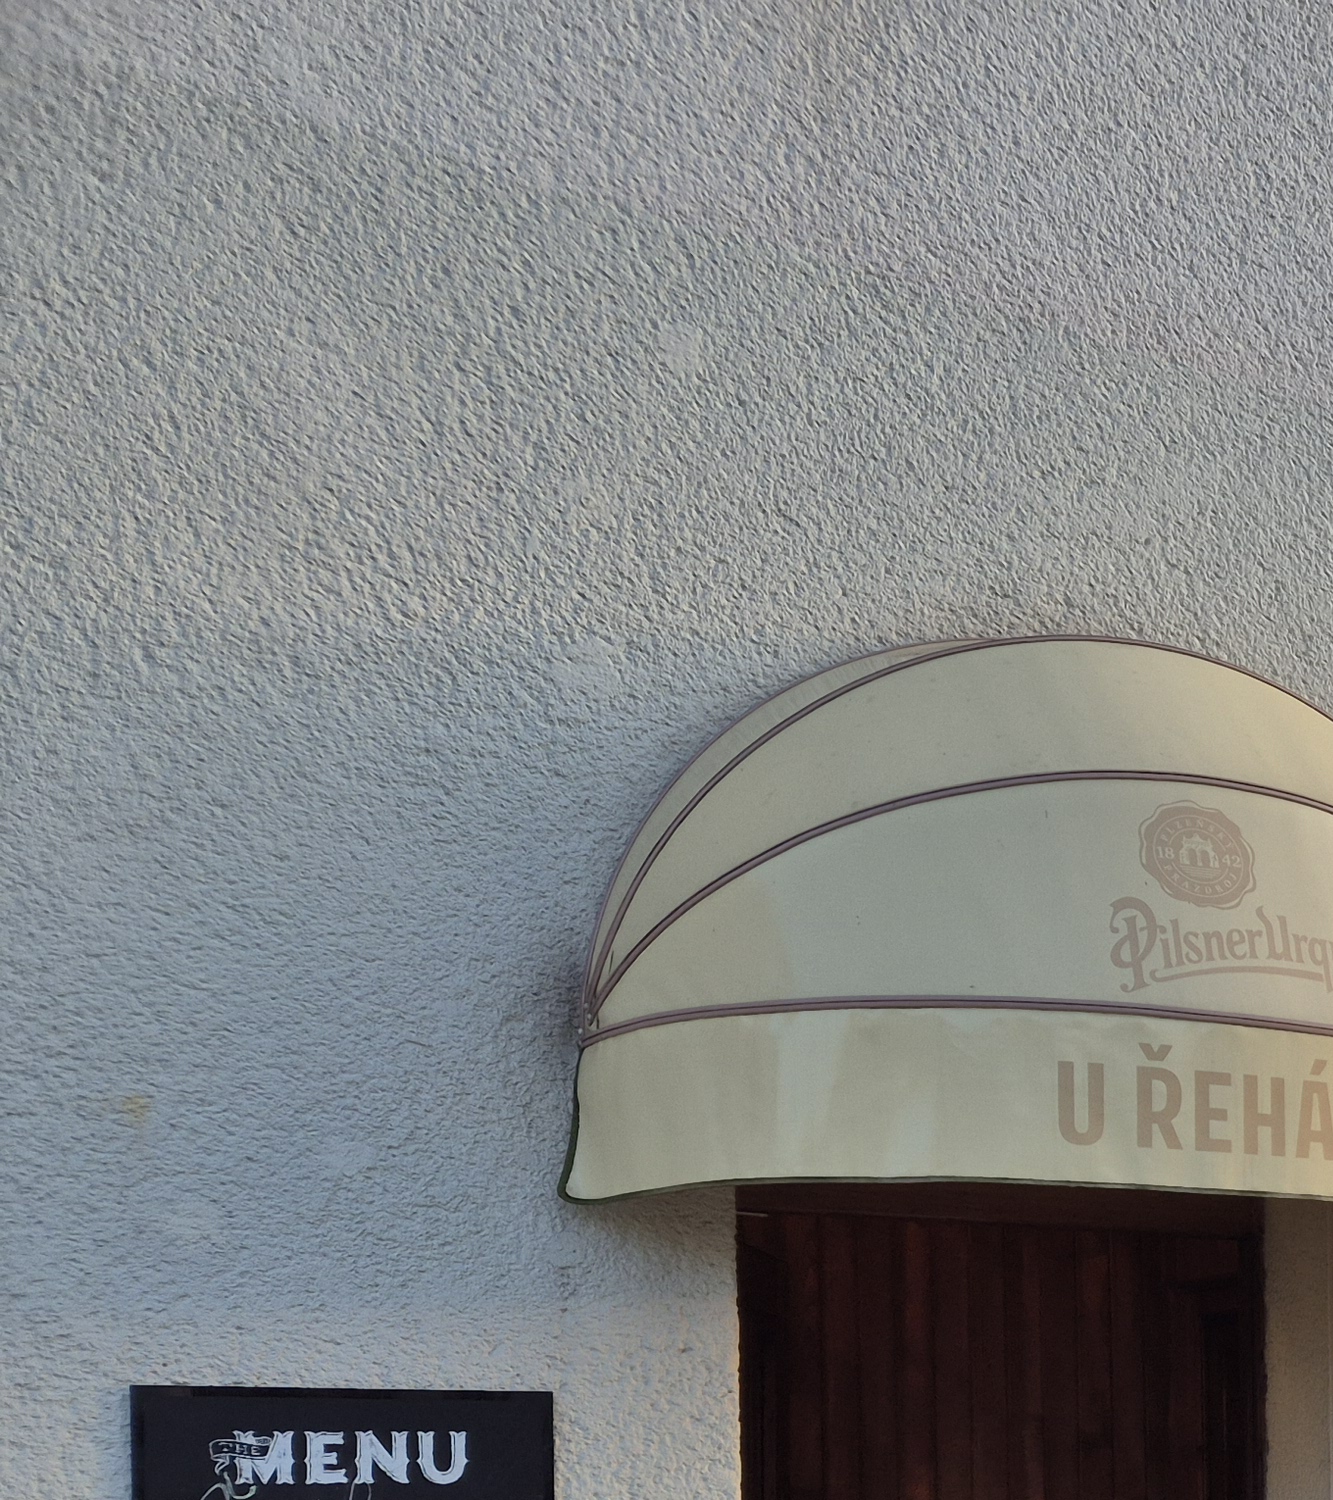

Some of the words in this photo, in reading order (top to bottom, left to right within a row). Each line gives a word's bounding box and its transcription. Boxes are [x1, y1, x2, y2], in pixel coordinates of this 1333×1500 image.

[1156, 846, 1175, 860] 18
[1221, 854, 1242, 868] 42
[1109, 896, 1263, 993] Pilsner
[1056, 1060, 1105, 1147] U
[220, 1442, 261, 1456] THE
[232, 1429, 470, 1485] MENU
